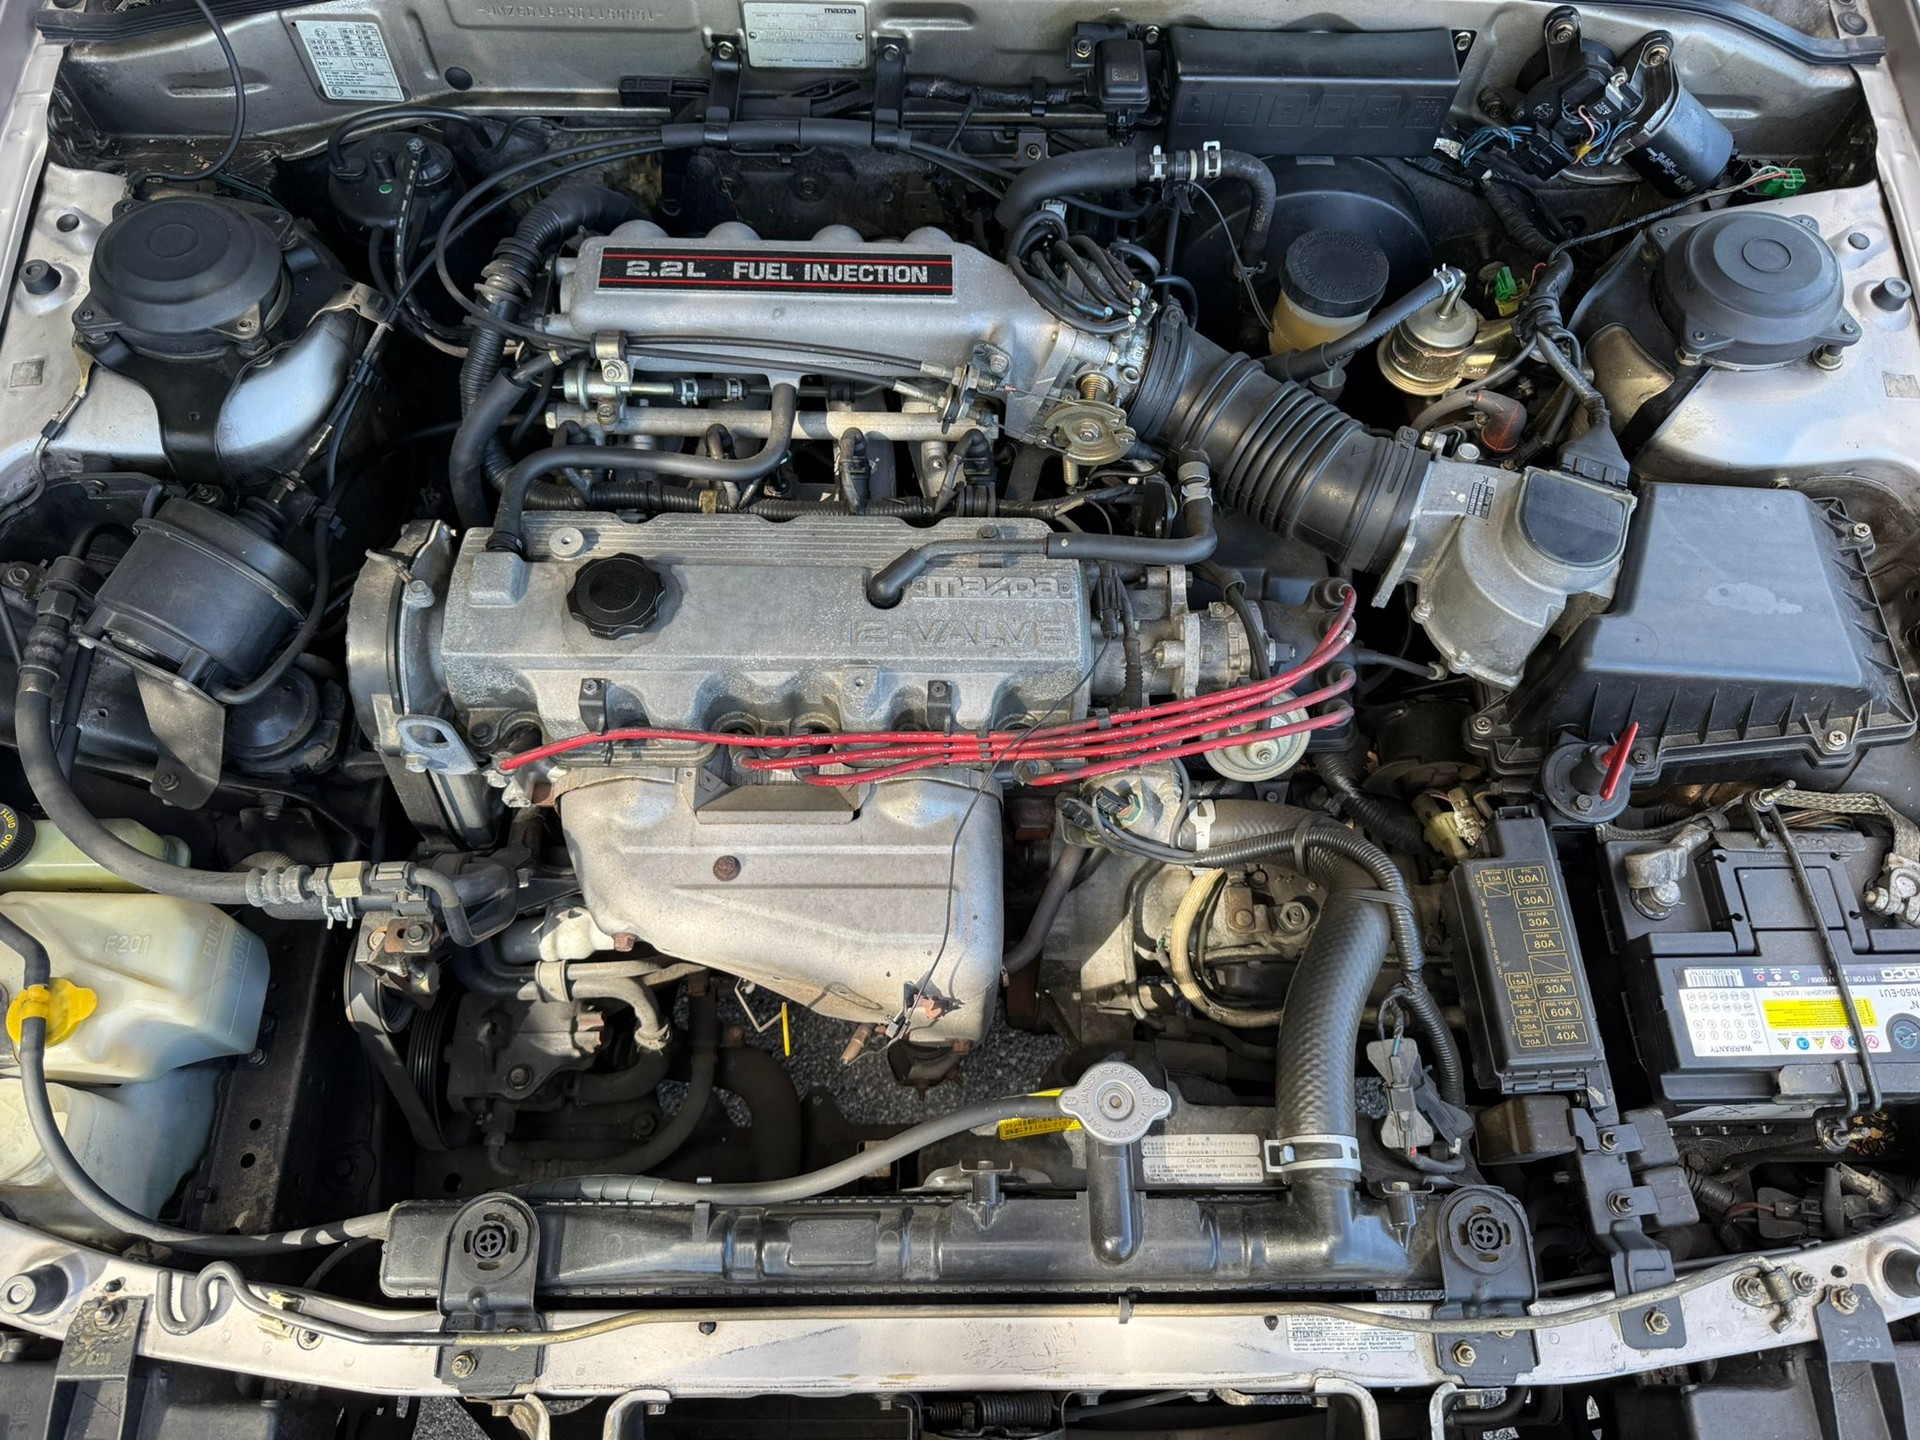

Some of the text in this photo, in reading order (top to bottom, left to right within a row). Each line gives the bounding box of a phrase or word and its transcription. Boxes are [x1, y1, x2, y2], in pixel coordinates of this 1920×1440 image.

[626, 260, 928, 283] 2.2L FUEL INJECTION
[926, 576, 1060, 599] mazda
[839, 619, 1067, 647] 12-VALVE
[0, 808, 16, 849] FLUID ON
[1518, 874, 1539, 883] 30A
[1523, 896, 1544, 904] 30A
[1528, 918, 1550, 926] 30A
[202, 918, 223, 958] FULL
[104, 934, 150, 954] F201
[1534, 940, 1555, 948] 80A
[1545, 984, 1567, 993] 30A
[1550, 1008, 1572, 1017] 60A
[1556, 1031, 1578, 1040] 40A
[1710, 1044, 1752, 1053] WARRANTY
[1100, 1066, 1126, 1076] NEVER
[1126, 1071, 1146, 1090] OPEN
